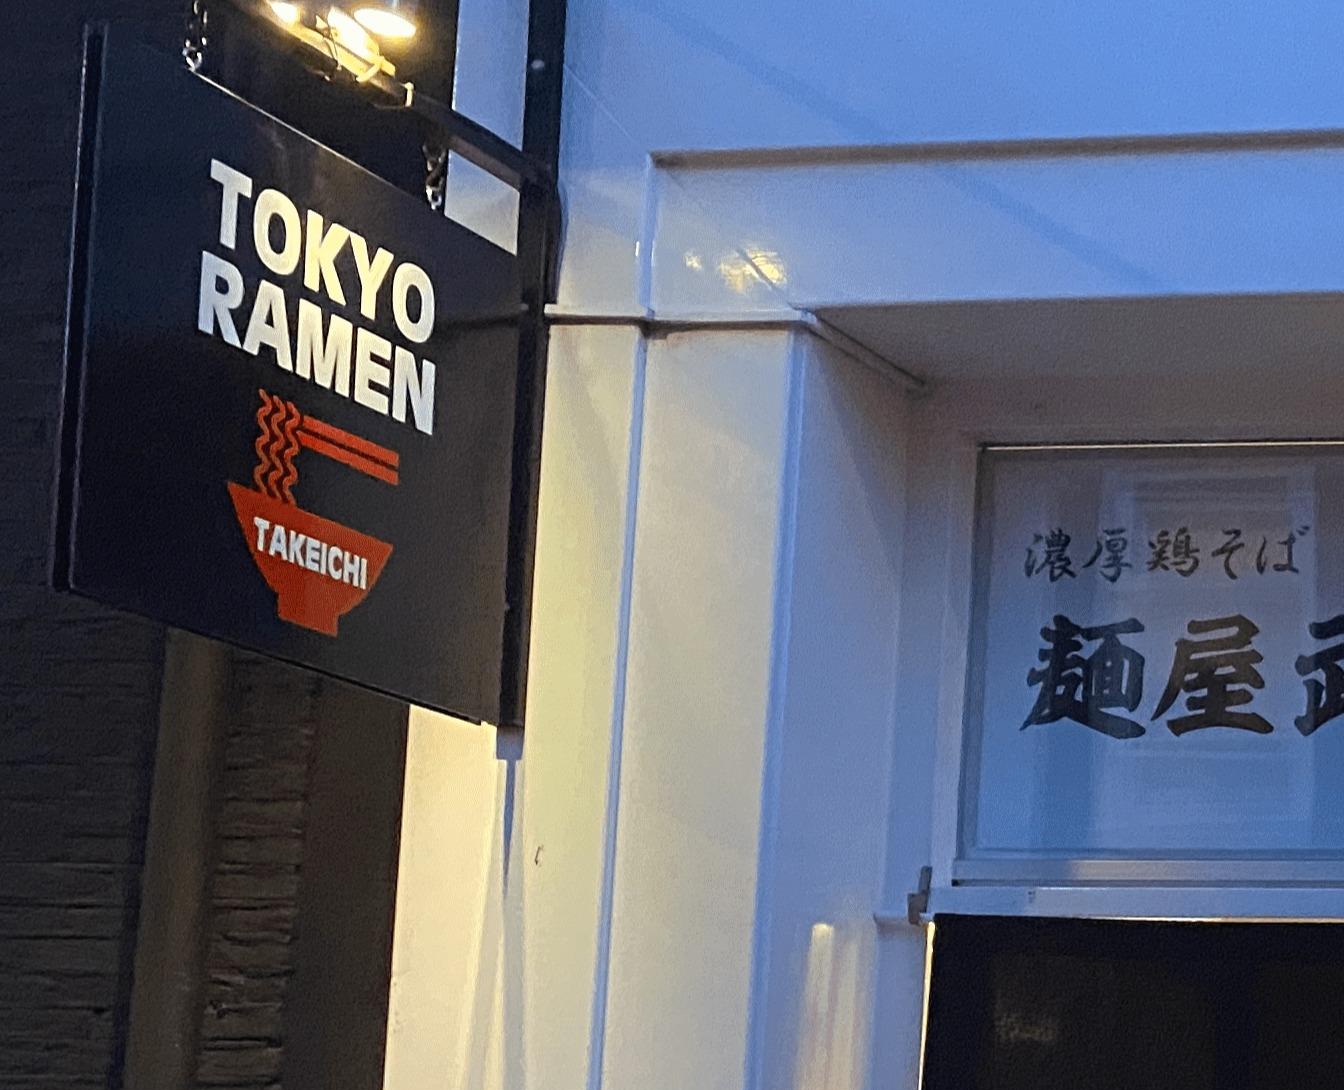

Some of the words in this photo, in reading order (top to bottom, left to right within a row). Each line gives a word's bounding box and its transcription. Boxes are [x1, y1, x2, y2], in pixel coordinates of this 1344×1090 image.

[209, 158, 436, 344] TOKYO
[198, 251, 436, 436] RAMEN
[253, 516, 369, 591] TAKEICHI
[1022, 525, 1310, 583] 濃厚鶏そば
